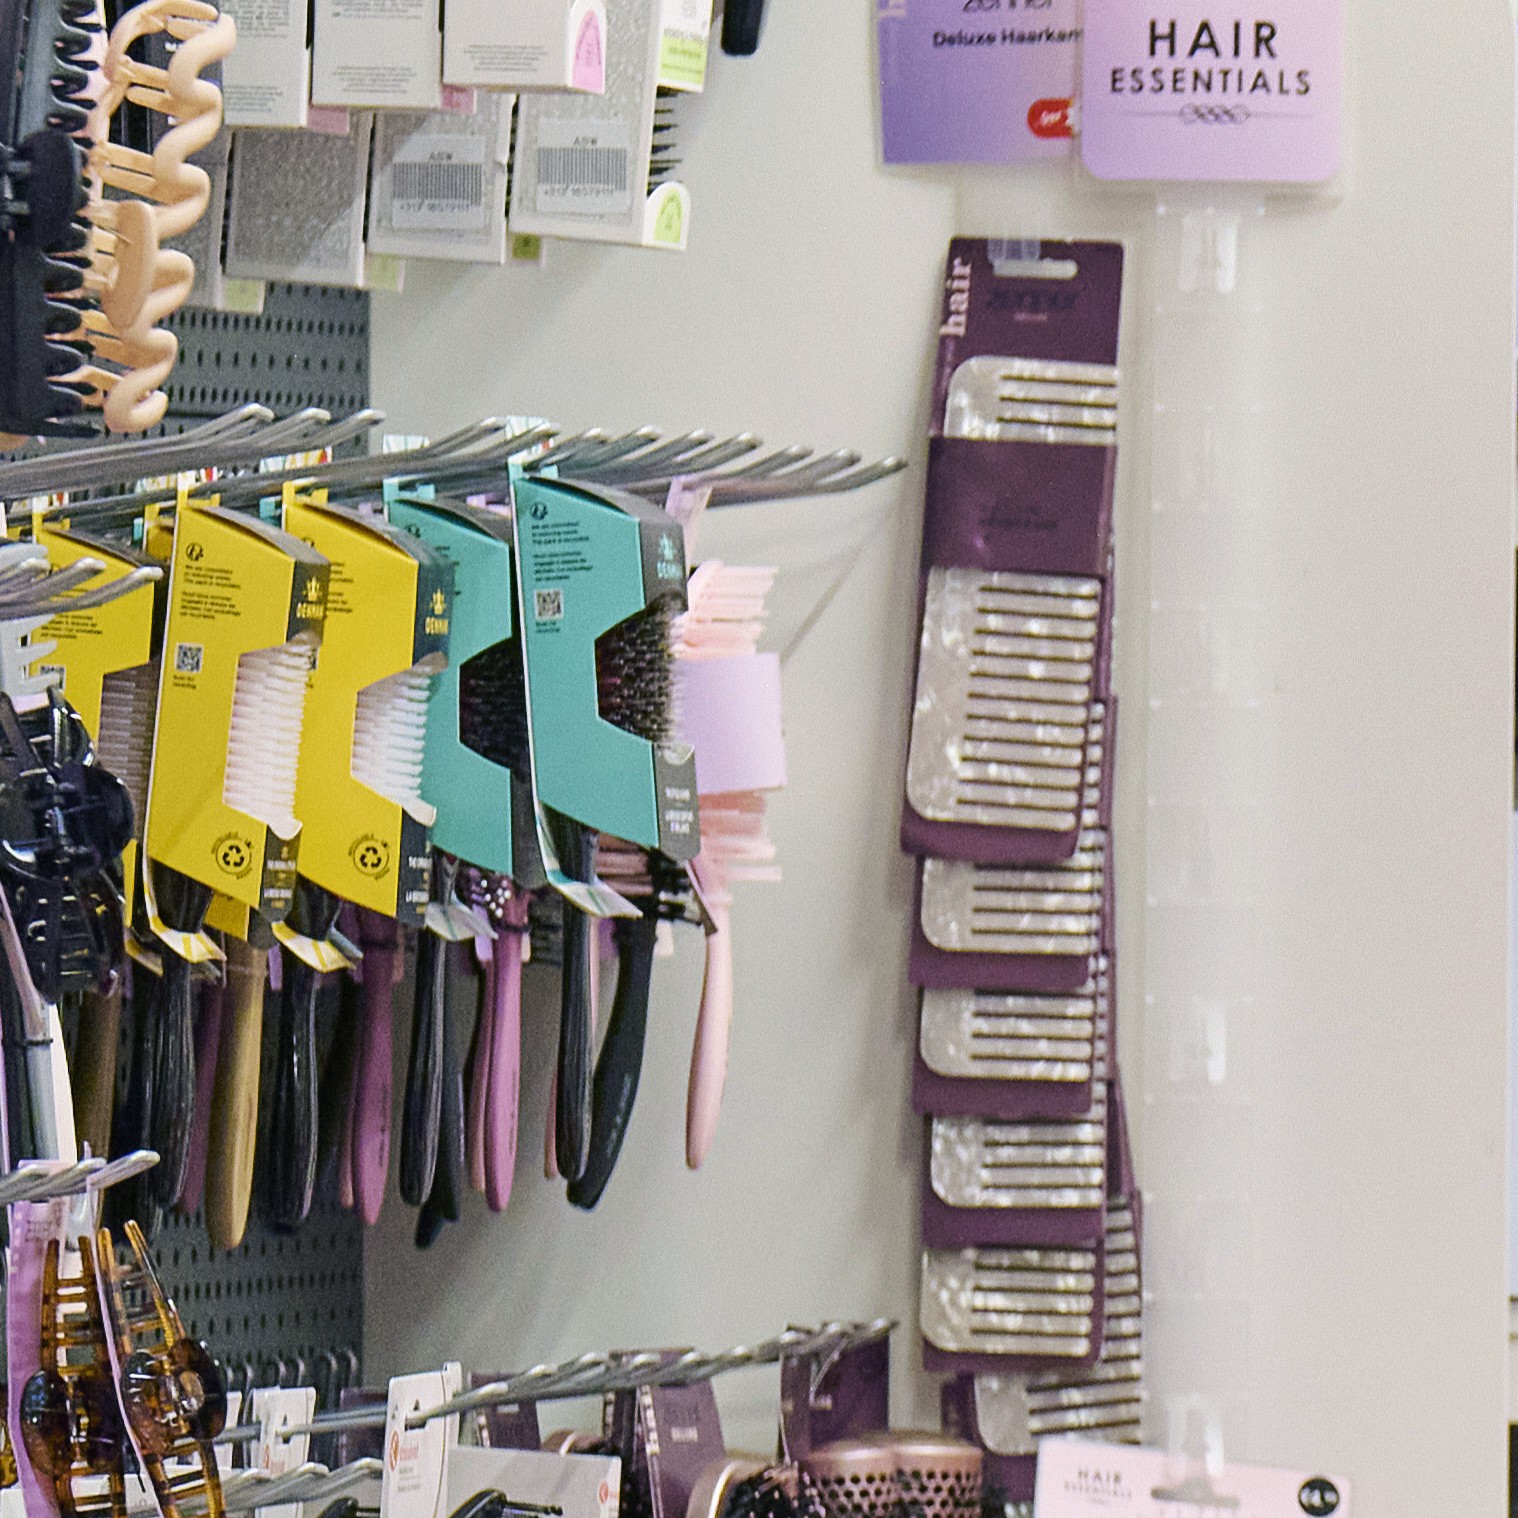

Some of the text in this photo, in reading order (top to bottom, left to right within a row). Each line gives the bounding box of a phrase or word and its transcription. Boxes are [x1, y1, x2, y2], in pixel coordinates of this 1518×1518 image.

[933, 29, 997, 48] Deluxe
[1148, 19, 1279, 59] HAIR
[1110, 68, 1311, 95] ESSENTIALS
[940, 257, 971, 336] hair
